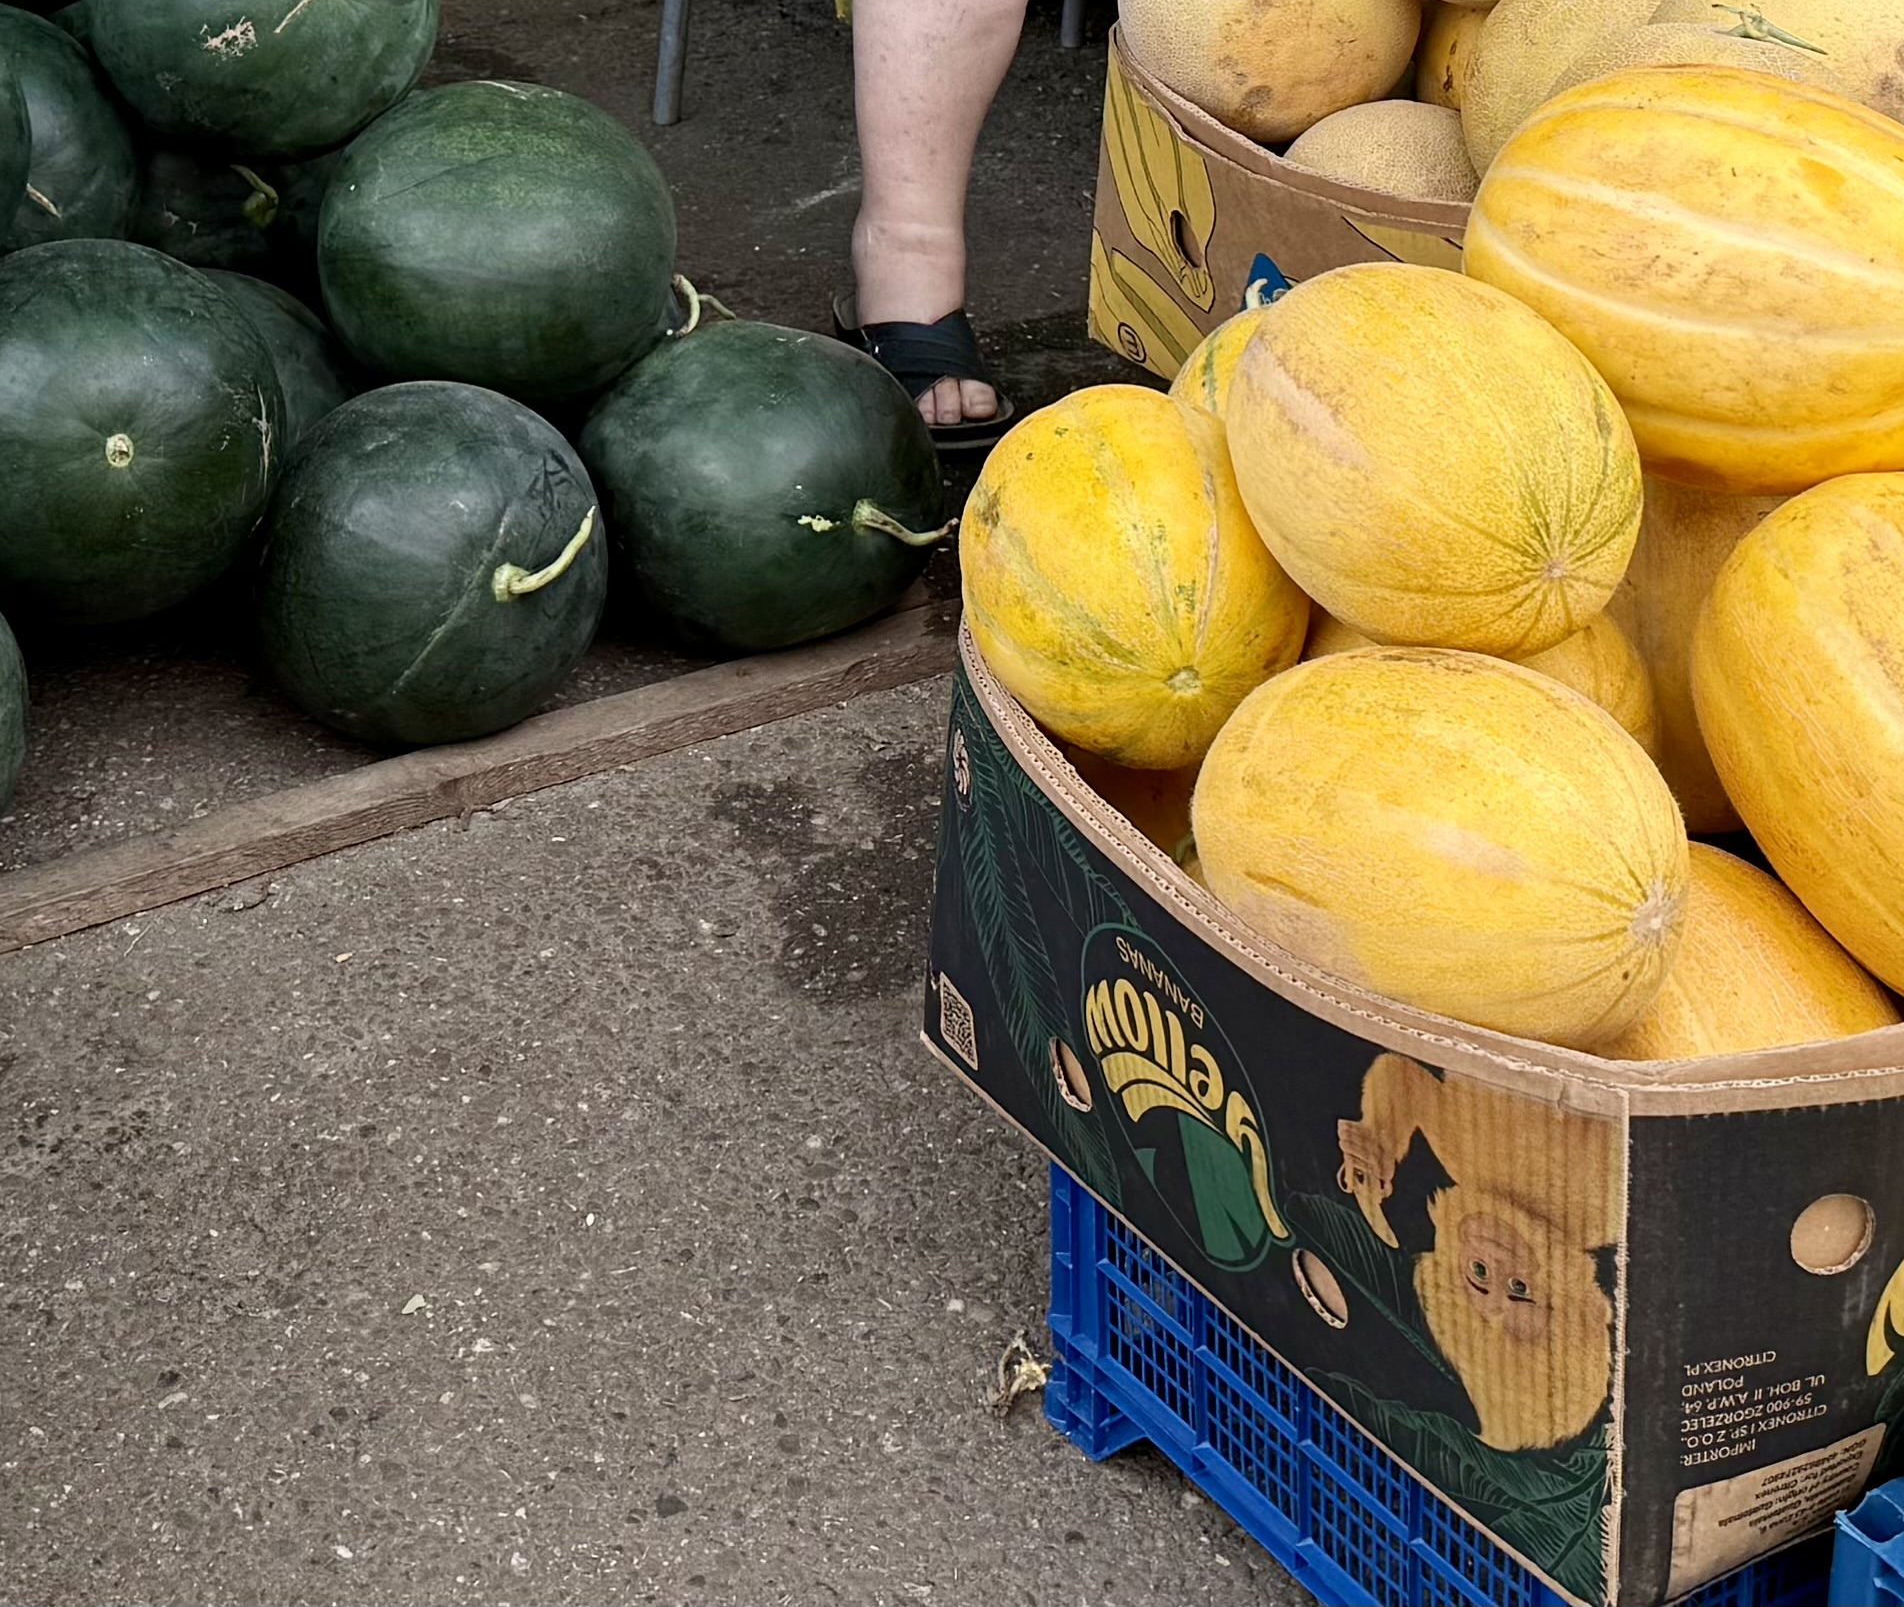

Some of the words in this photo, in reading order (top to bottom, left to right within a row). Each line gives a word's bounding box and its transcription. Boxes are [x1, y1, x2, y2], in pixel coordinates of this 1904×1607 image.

[1115, 935, 1205, 1030] BANANAS
[1684, 1350, 1777, 1377] CITRONEX.PL
[1681, 1375, 1745, 1397] POLAND
[1769, 1379, 1801, 1397] BOH.
[1767, 1392, 1813, 1413] 59-900
[1681, 1404, 1764, 1433] ZGORZELEC
[1758, 1404, 1828, 1432] CITRONEX
[1717, 1430, 1726, 1443] Z
[1680, 1439, 1756, 1467] IMPORTER:
